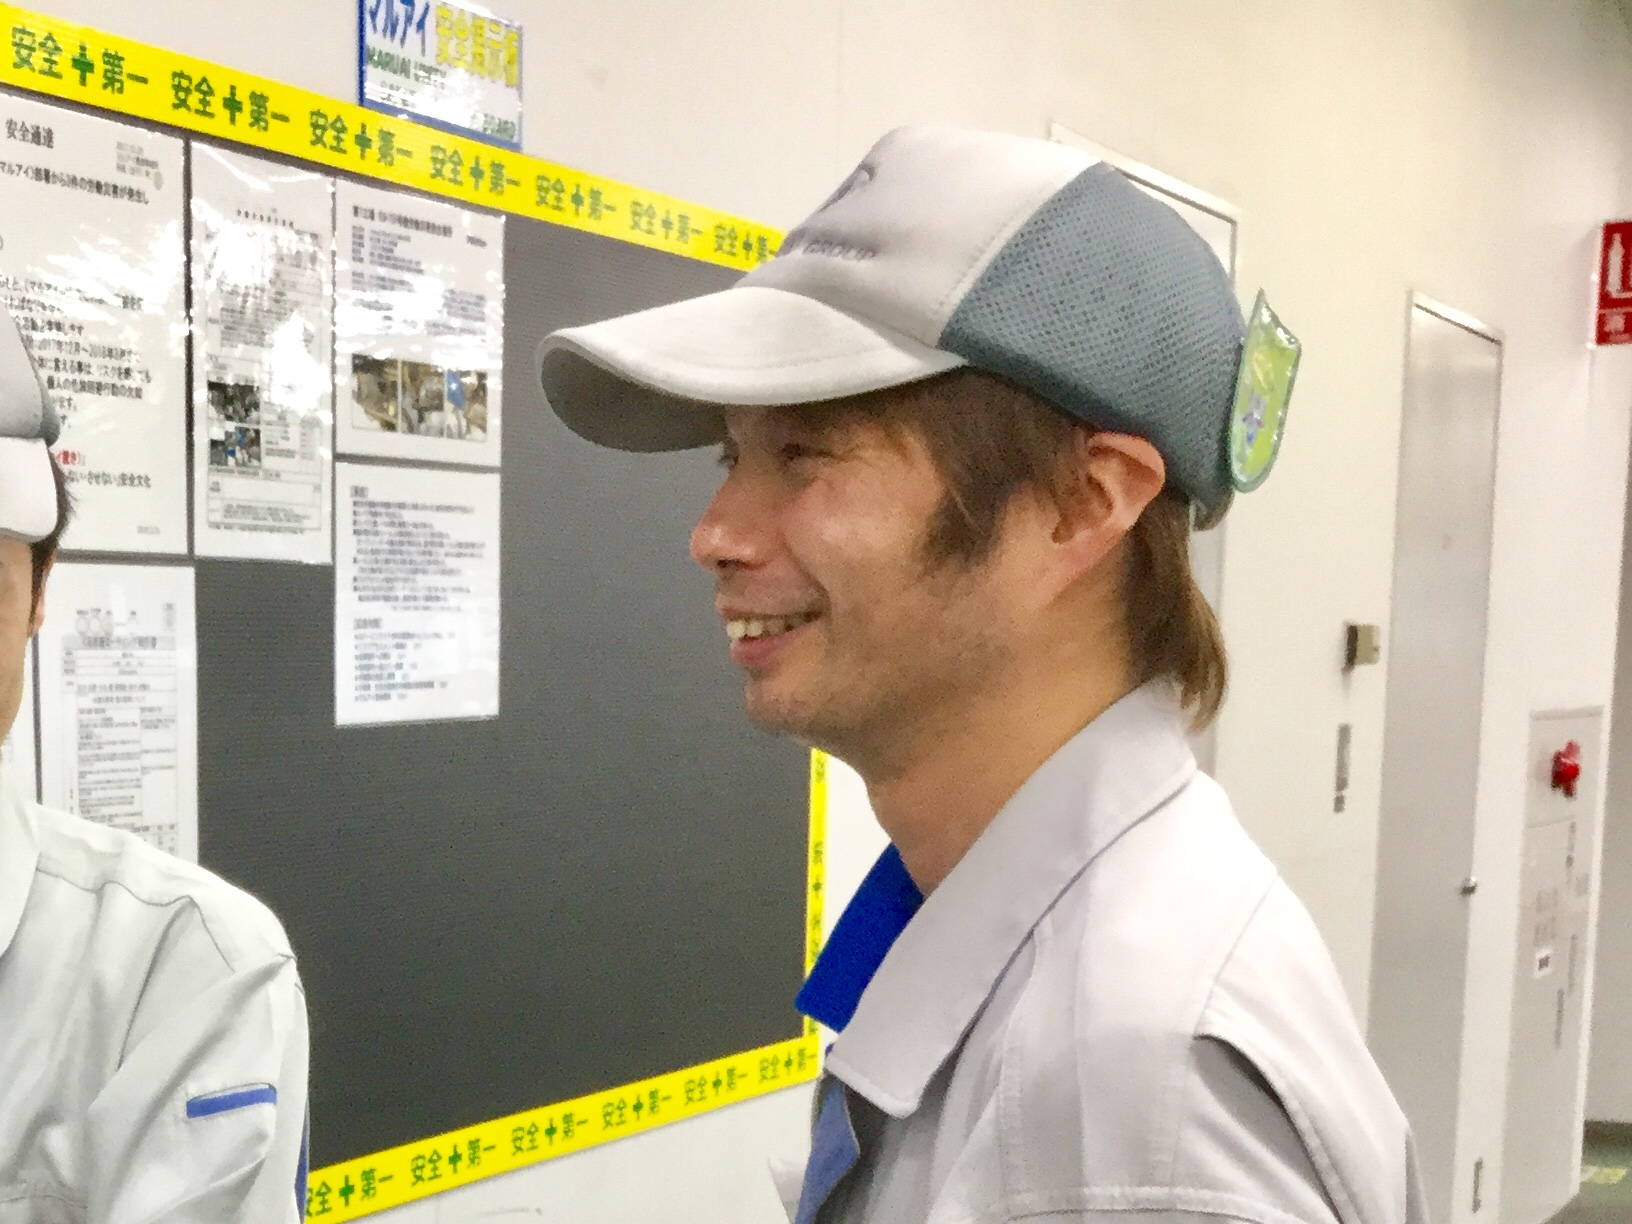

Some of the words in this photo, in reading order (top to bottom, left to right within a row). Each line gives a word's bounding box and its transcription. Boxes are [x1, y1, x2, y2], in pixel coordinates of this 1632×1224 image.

[11, 26, 64, 80] 安全
[101, 47, 149, 95] 第一
[171, 70, 216, 119] 安全
[248, 89, 291, 132] 第一
[309, 110, 348, 155] 安全
[360, 1168, 394, 1200] 第一
[411, 1149, 442, 1187] 安全
[466, 1137, 497, 1168] 第一
[511, 1121, 540, 1156] 安全
